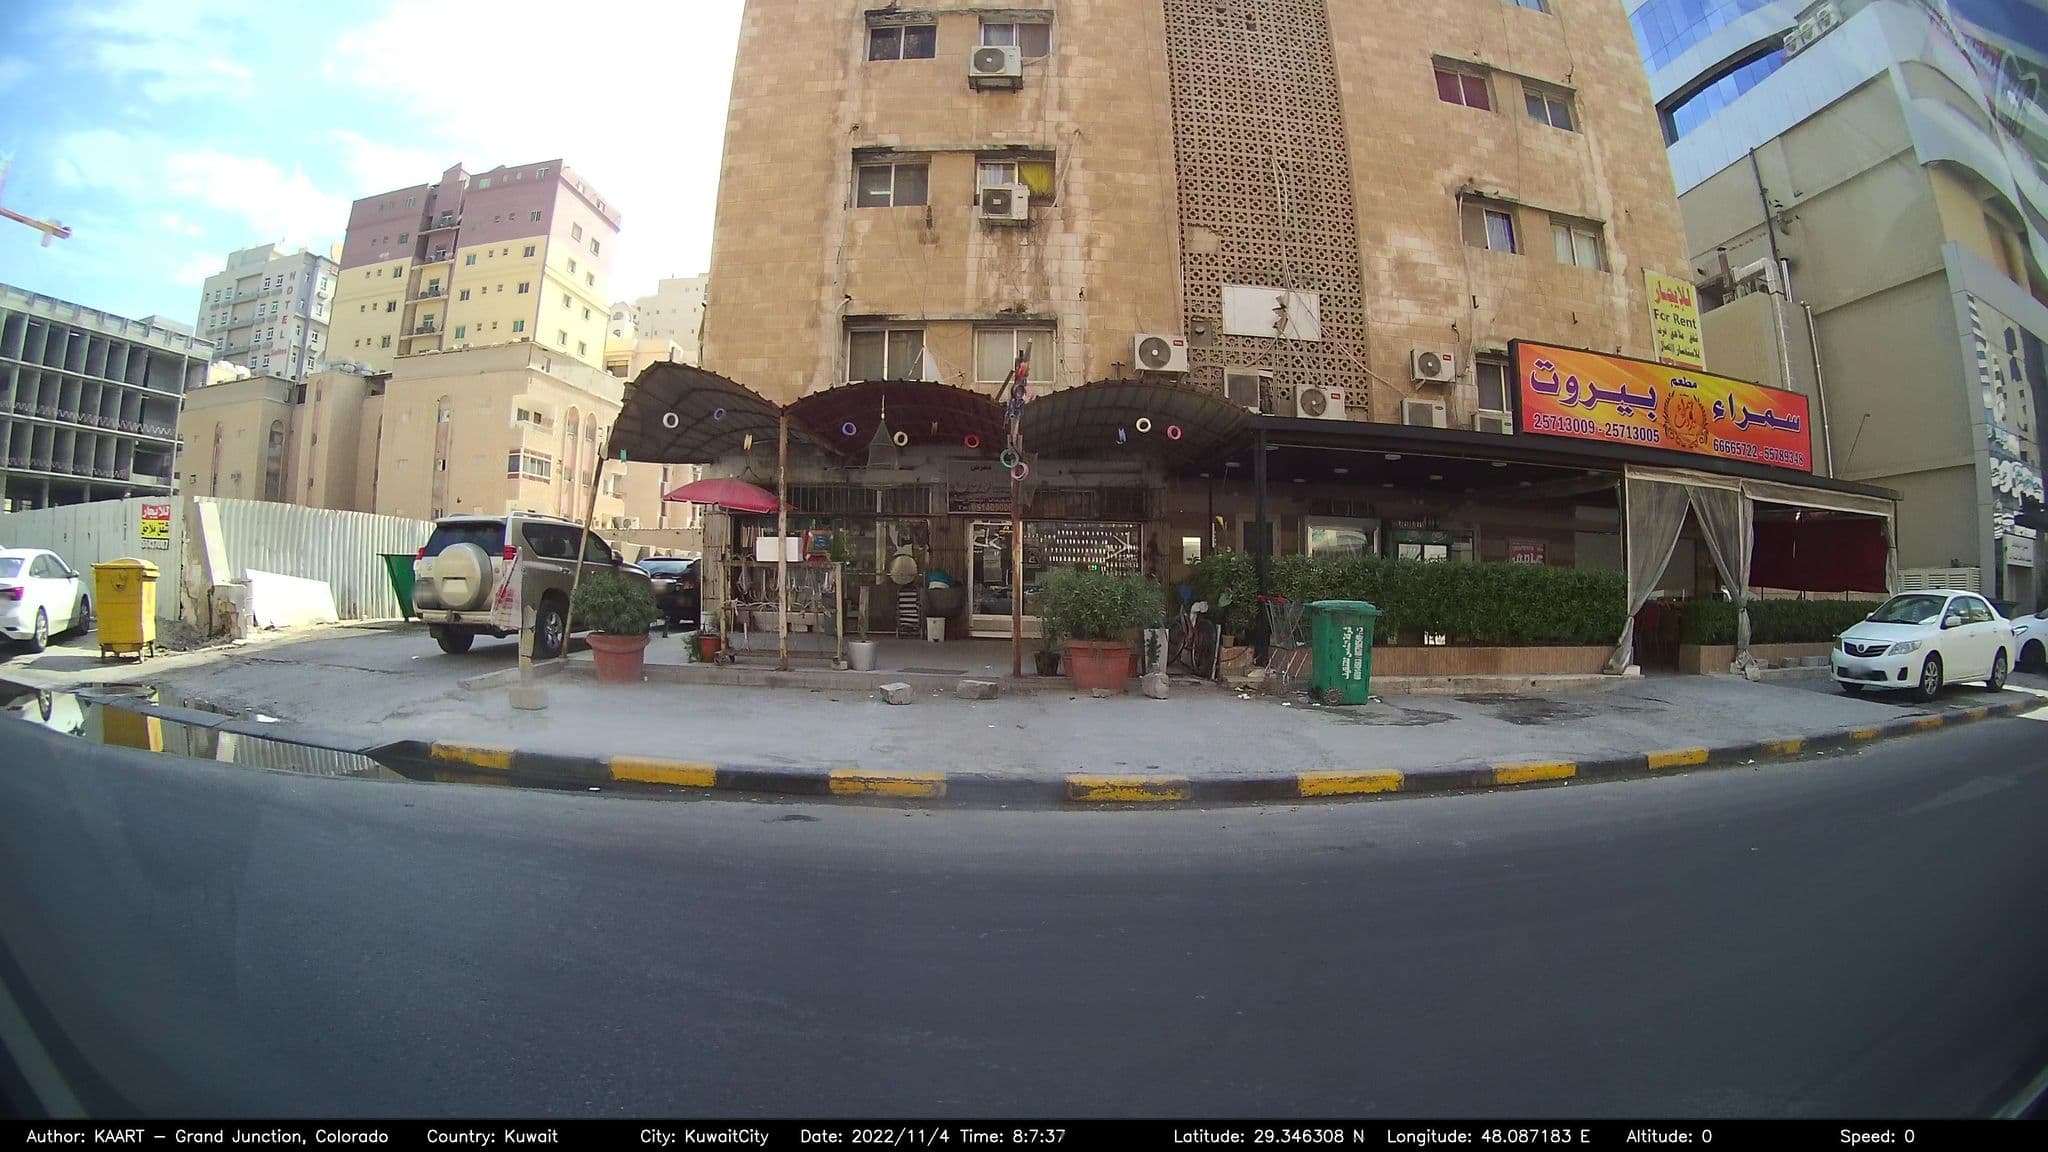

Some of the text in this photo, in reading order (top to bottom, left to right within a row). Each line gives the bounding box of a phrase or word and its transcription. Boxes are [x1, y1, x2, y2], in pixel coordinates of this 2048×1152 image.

[279, 271, 297, 339] HOTEL
[1653, 308, 1697, 329] For Rent
[1529, 359, 1801, 432] سمراء بيروت
[1670, 376, 1698, 390] مطعم
[1533, 413, 1596, 434] 25713009
[1604, 422, 1660, 443] 25713005
[1713, 438, 1758, 458] 66665722
